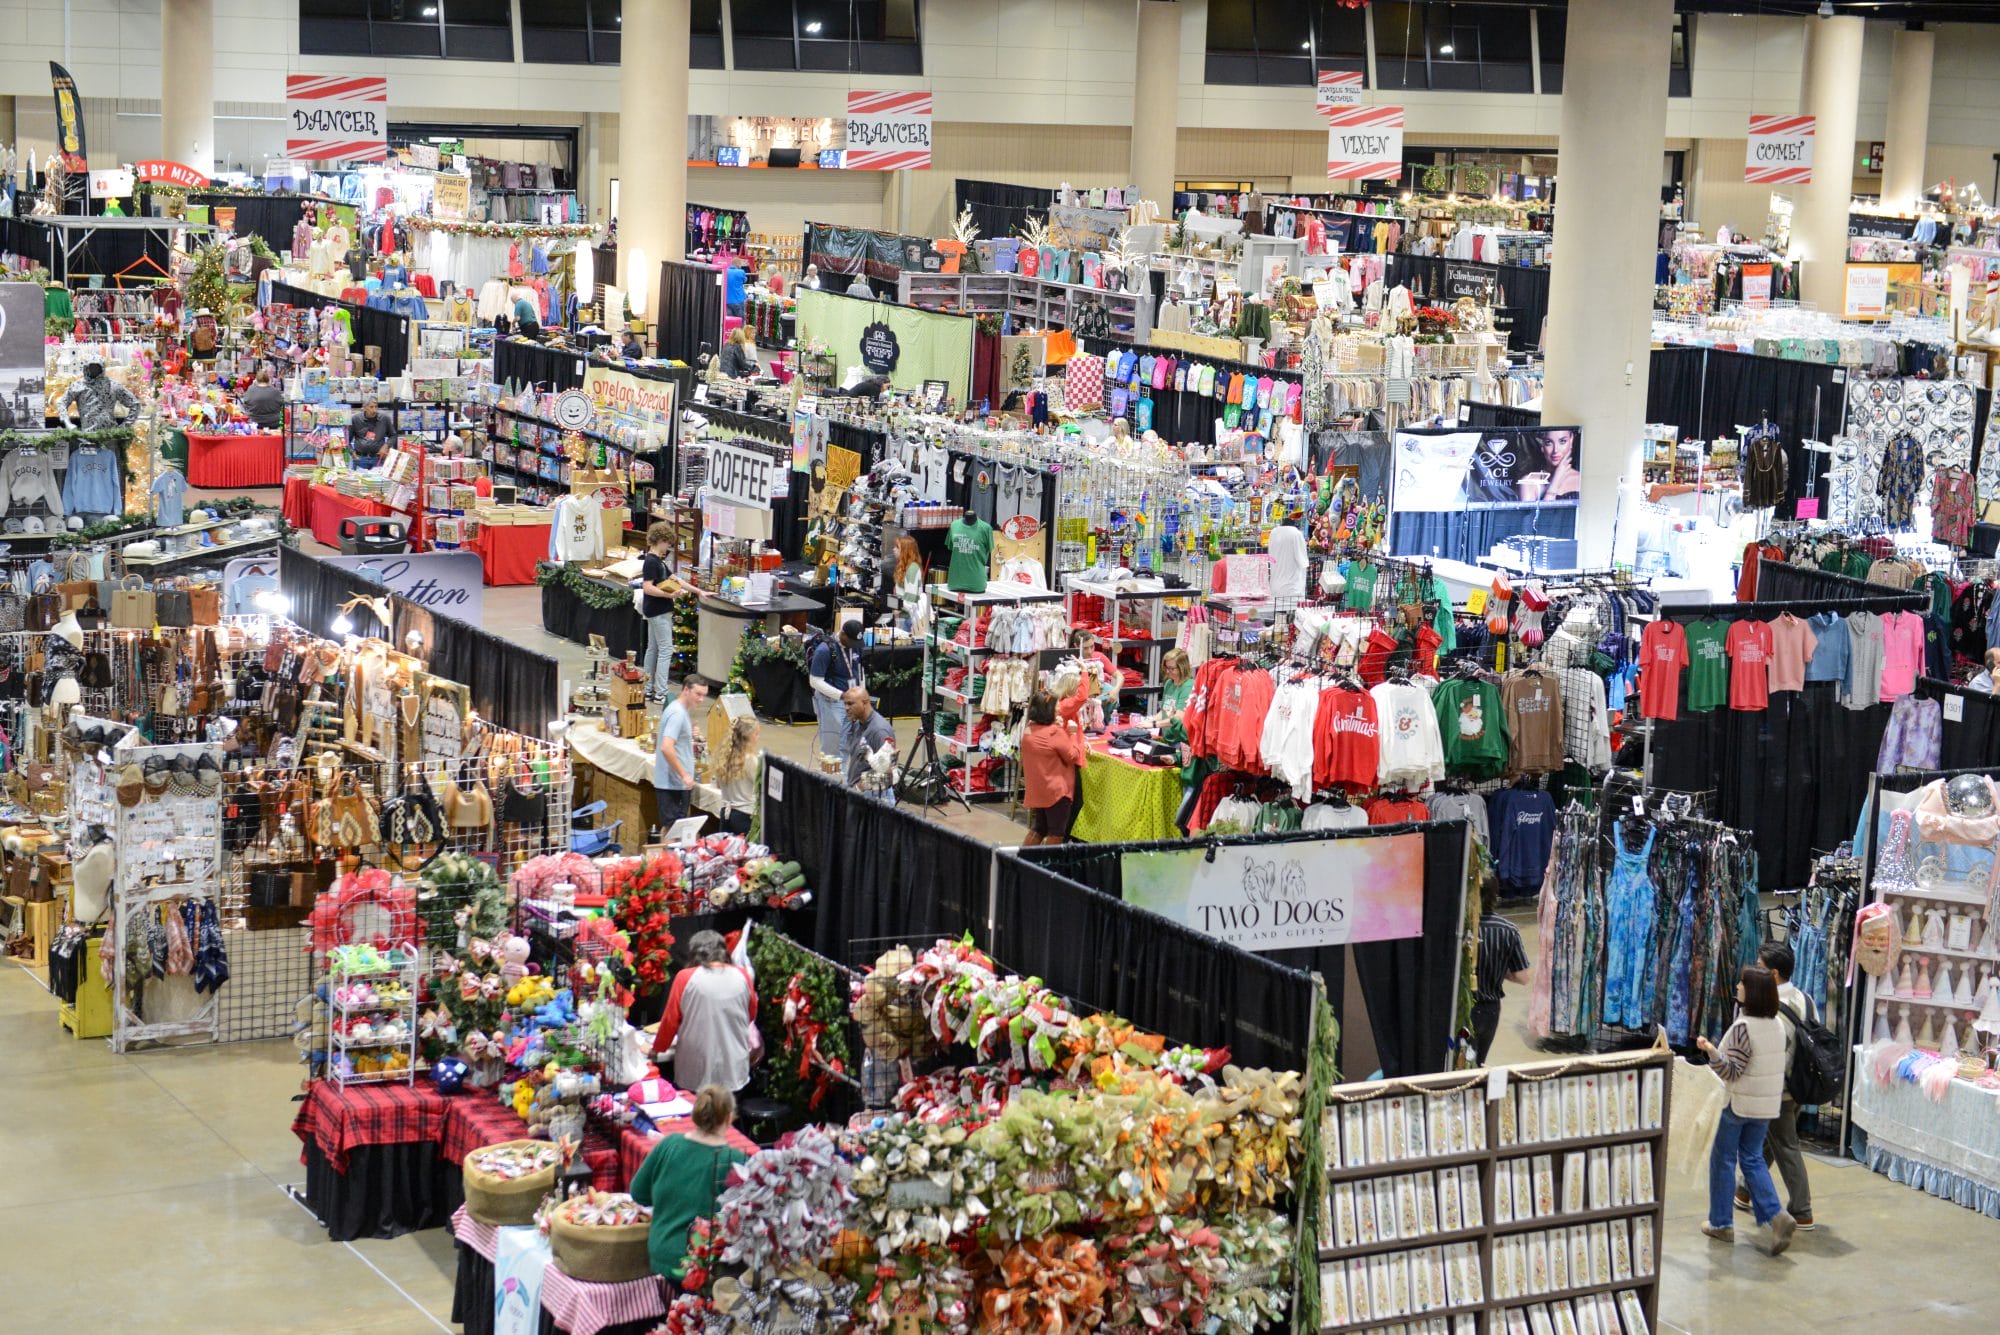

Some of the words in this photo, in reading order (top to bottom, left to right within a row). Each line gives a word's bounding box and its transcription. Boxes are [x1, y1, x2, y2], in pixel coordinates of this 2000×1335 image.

[293, 109, 379, 136] DANCER
[847, 119, 930, 147] PRANCER
[1340, 135, 1390, 156] VIXEN
[1756, 140, 1805, 161] COMET
[151, 164, 166, 177] BY
[171, 166, 202, 187] MIZE
[636, 387, 670, 412] Special
[15, 465, 42, 479] COOSA
[711, 448, 769, 504] COFFEE
[1485, 467, 1509, 479] ACE
[1480, 479, 1513, 488] JEWELRY
[1198, 903, 1260, 932] TWO
[1273, 898, 1344, 926] DOGS
[1219, 933, 1243, 943] ART
[1253, 931, 1277, 941] AND
[1286, 928, 1325, 938] GIFTS
